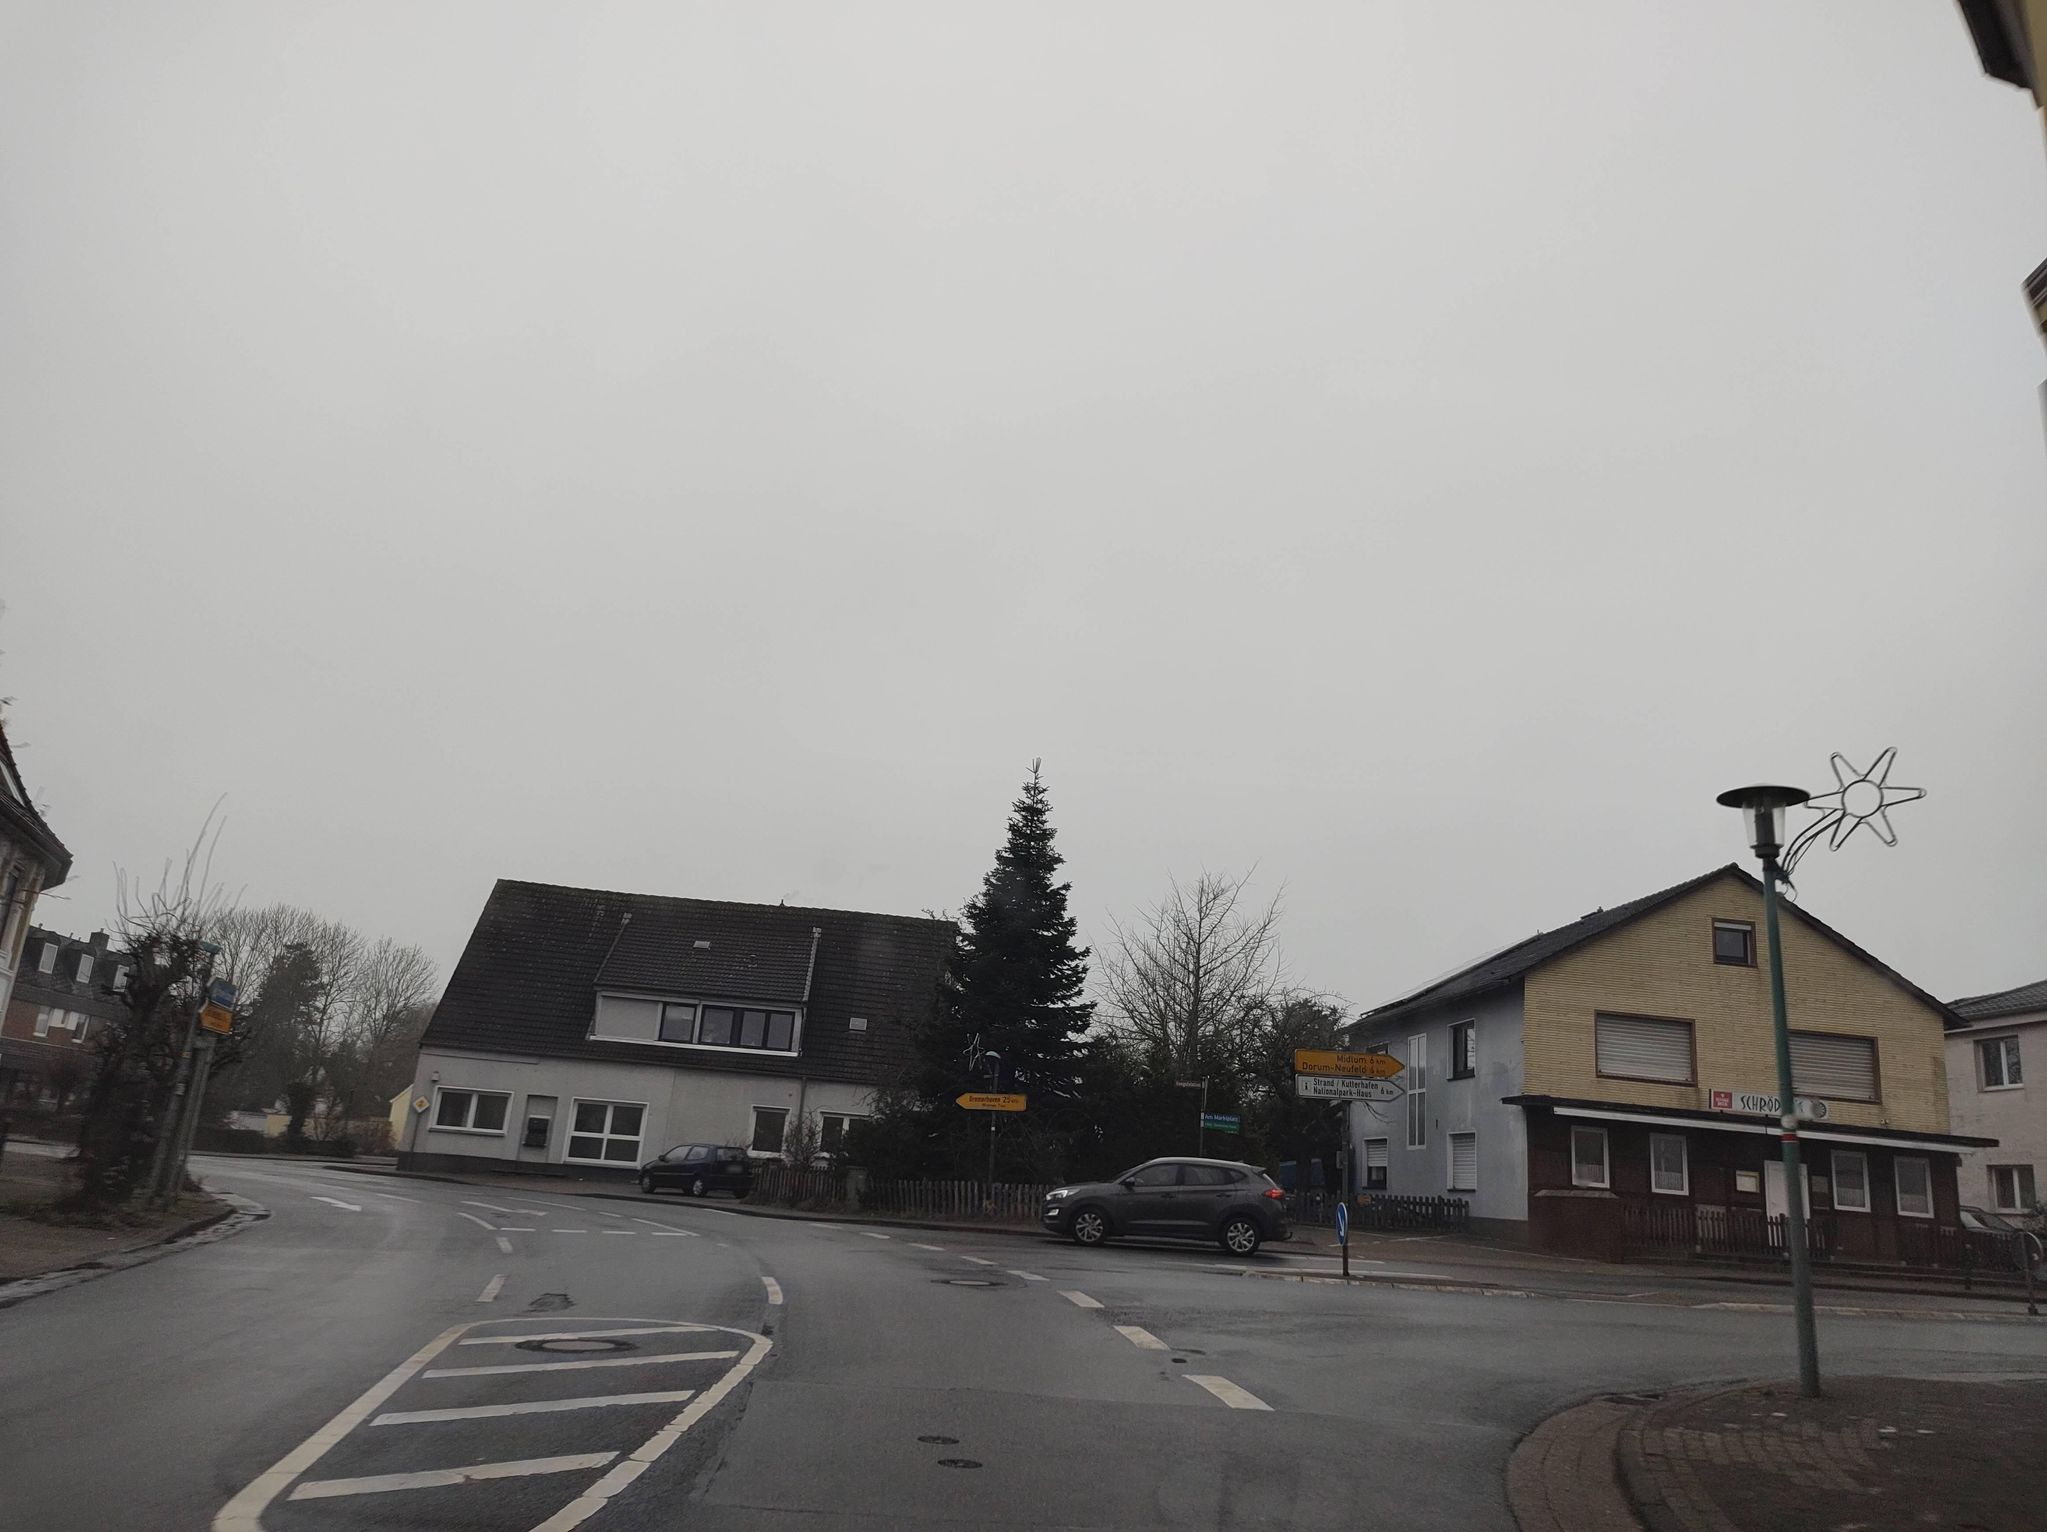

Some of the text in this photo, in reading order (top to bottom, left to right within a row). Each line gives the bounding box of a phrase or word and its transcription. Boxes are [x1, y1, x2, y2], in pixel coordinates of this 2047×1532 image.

[1336, 1055, 1367, 1064] Midlum
[1369, 1056, 1375, 1065] 6
[1302, 1062, 1367, 1074] Dorum-Neufeld
[1313, 1078, 1335, 1087] Strand
[1341, 1080, 1379, 1090] Kutterhafen
[1313, 1086, 1372, 1099] Nationalpark-Haus
[1740, 1095, 1781, 1113] SCHRÖD
